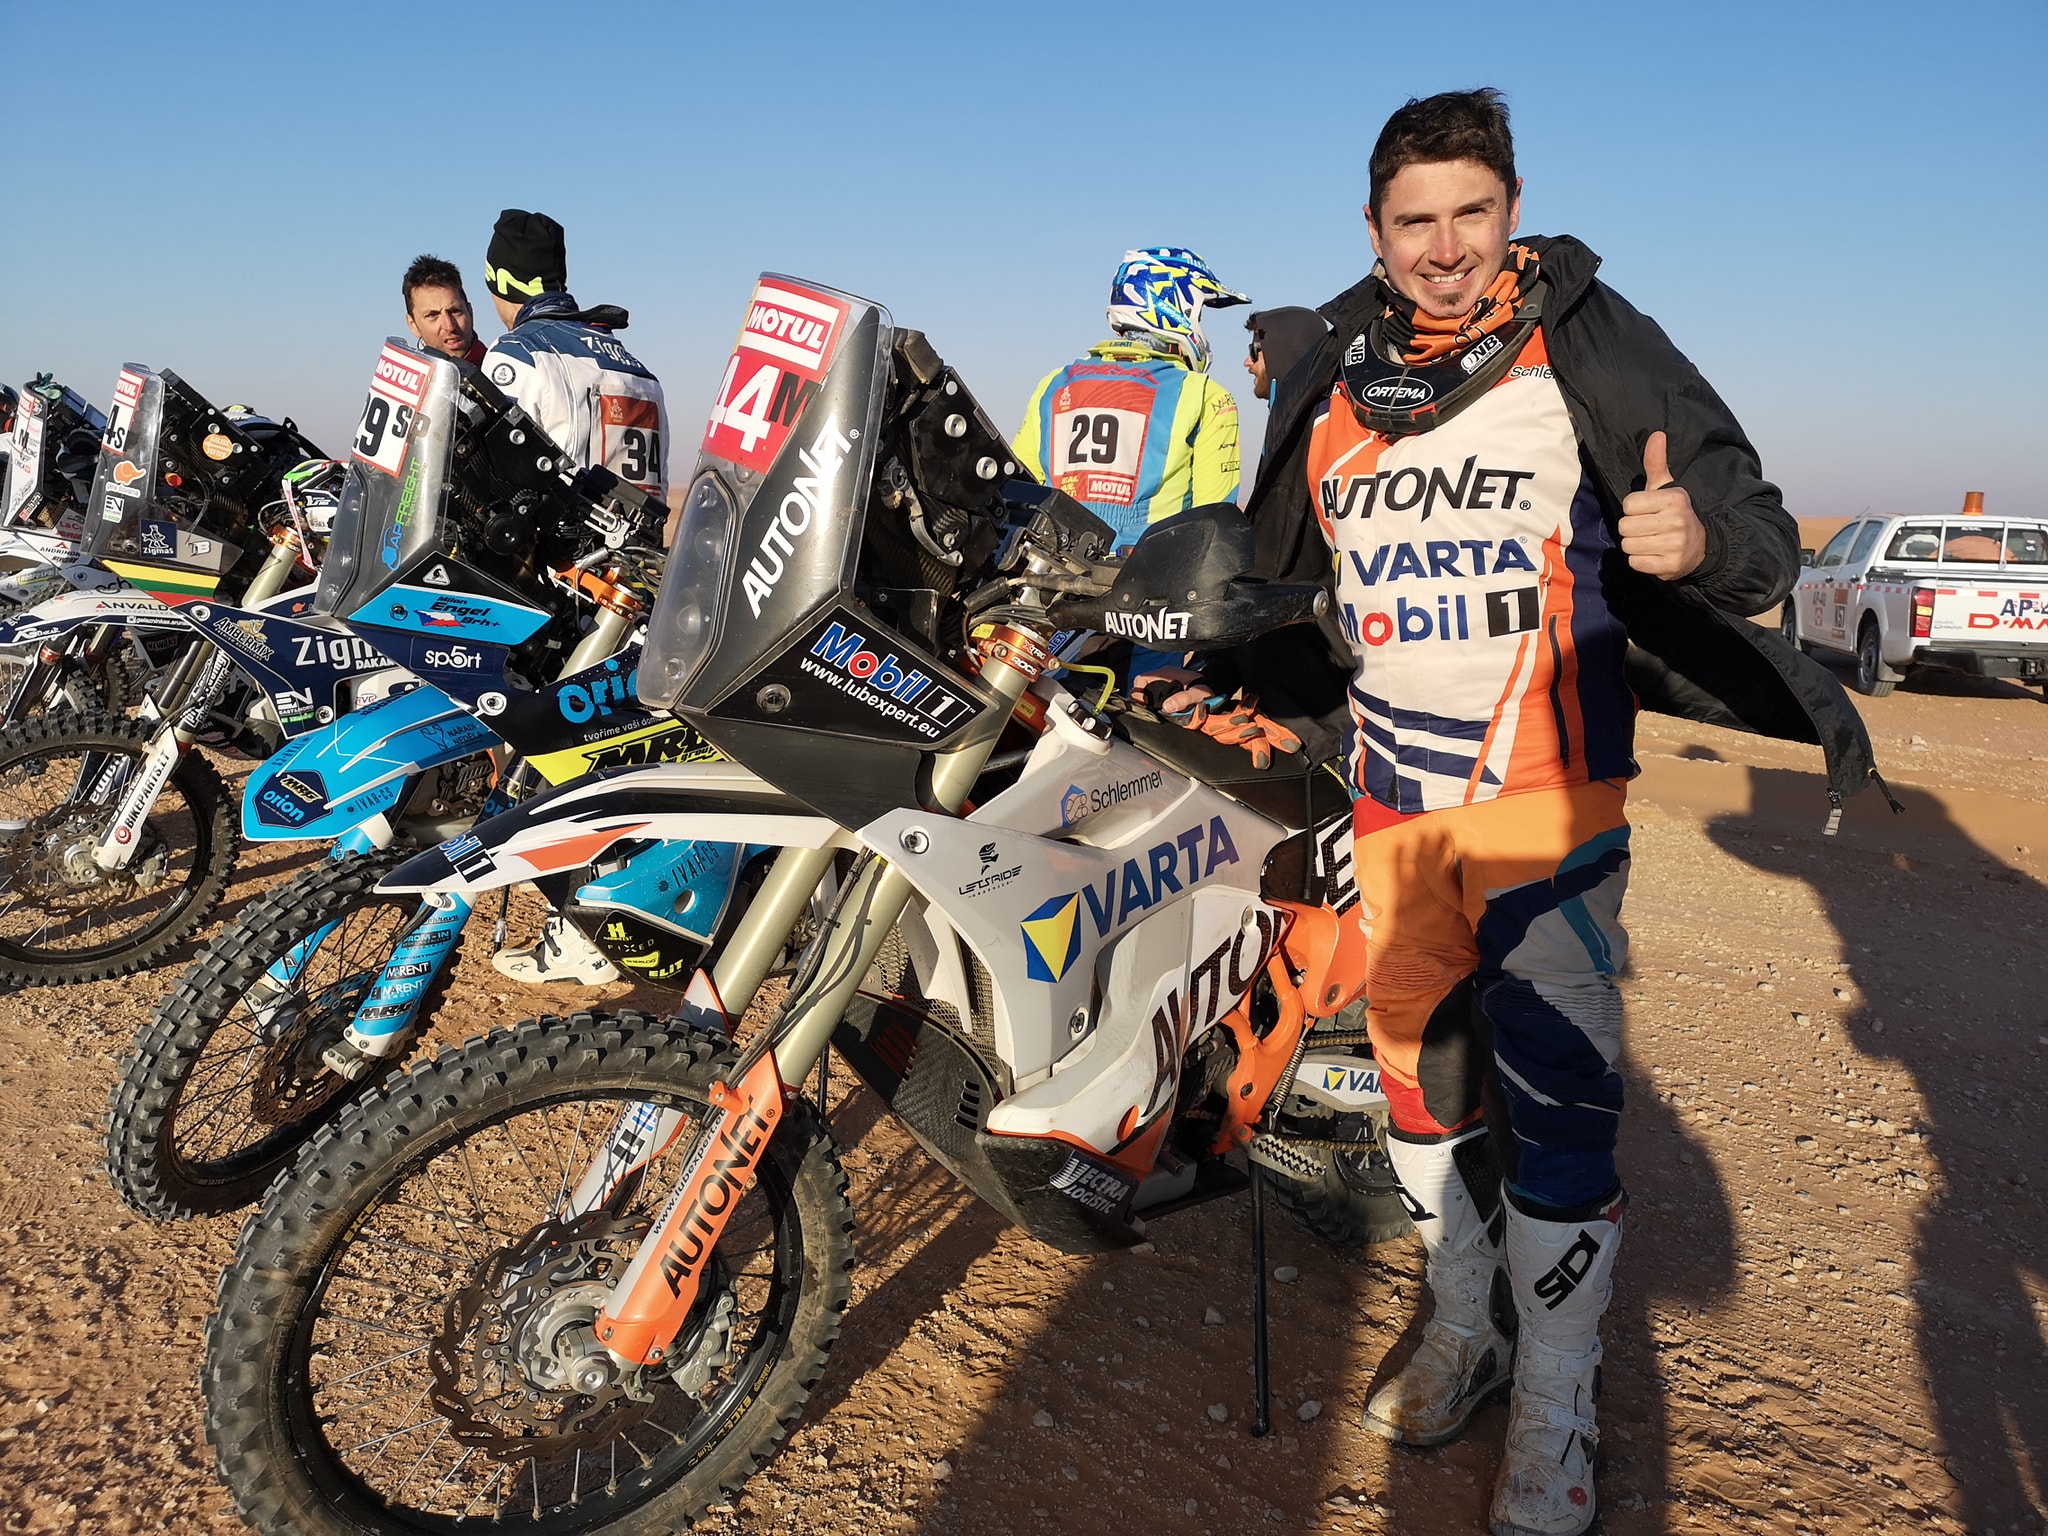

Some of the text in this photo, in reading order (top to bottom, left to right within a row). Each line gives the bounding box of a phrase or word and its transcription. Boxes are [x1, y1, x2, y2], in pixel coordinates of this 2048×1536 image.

[747, 305, 824, 349] MOTUL
[376, 358, 419, 391] MOTUL
[1367, 385, 1426, 400] ORTEMA
[768, 371, 822, 427] M
[353, 392, 390, 457] 9
[1068, 414, 1119, 464] 29
[621, 429, 661, 483] 34
[1090, 480, 1131, 495] MOTUL
[1321, 454, 1535, 523] AUTONET
[741, 412, 854, 620] AUTONET
[143, 547, 174, 556] Zigmas
[1350, 538, 1538, 587] VARTA
[430, 602, 491, 617] Engel
[437, 596, 468, 605] Milan
[1337, 594, 1470, 646] Mobil
[213, 616, 275, 661] AMBERMIX
[1105, 606, 1193, 643] AUTONET
[810, 621, 933, 705] Mobil
[1011, 656, 1038, 676] ROCS
[800, 657, 941, 739] www.lubexpert.eu
[584, 726, 620, 742] tvoříme
[622, 718, 640, 732] vaši
[124, 749, 170, 829] BIKEPARTS.LT
[263, 789, 305, 822] orion
[1090, 770, 1163, 813] Schlemmer
[1081, 815, 1240, 938] VARTA
[607, 938, 655, 953] FIXED
[648, 958, 684, 977] ELIT
[659, 1095, 771, 1300] AUTONET
[1062, 1184, 1117, 1215] LOGISTIC
[716, 1395, 752, 1437] EXCEL
